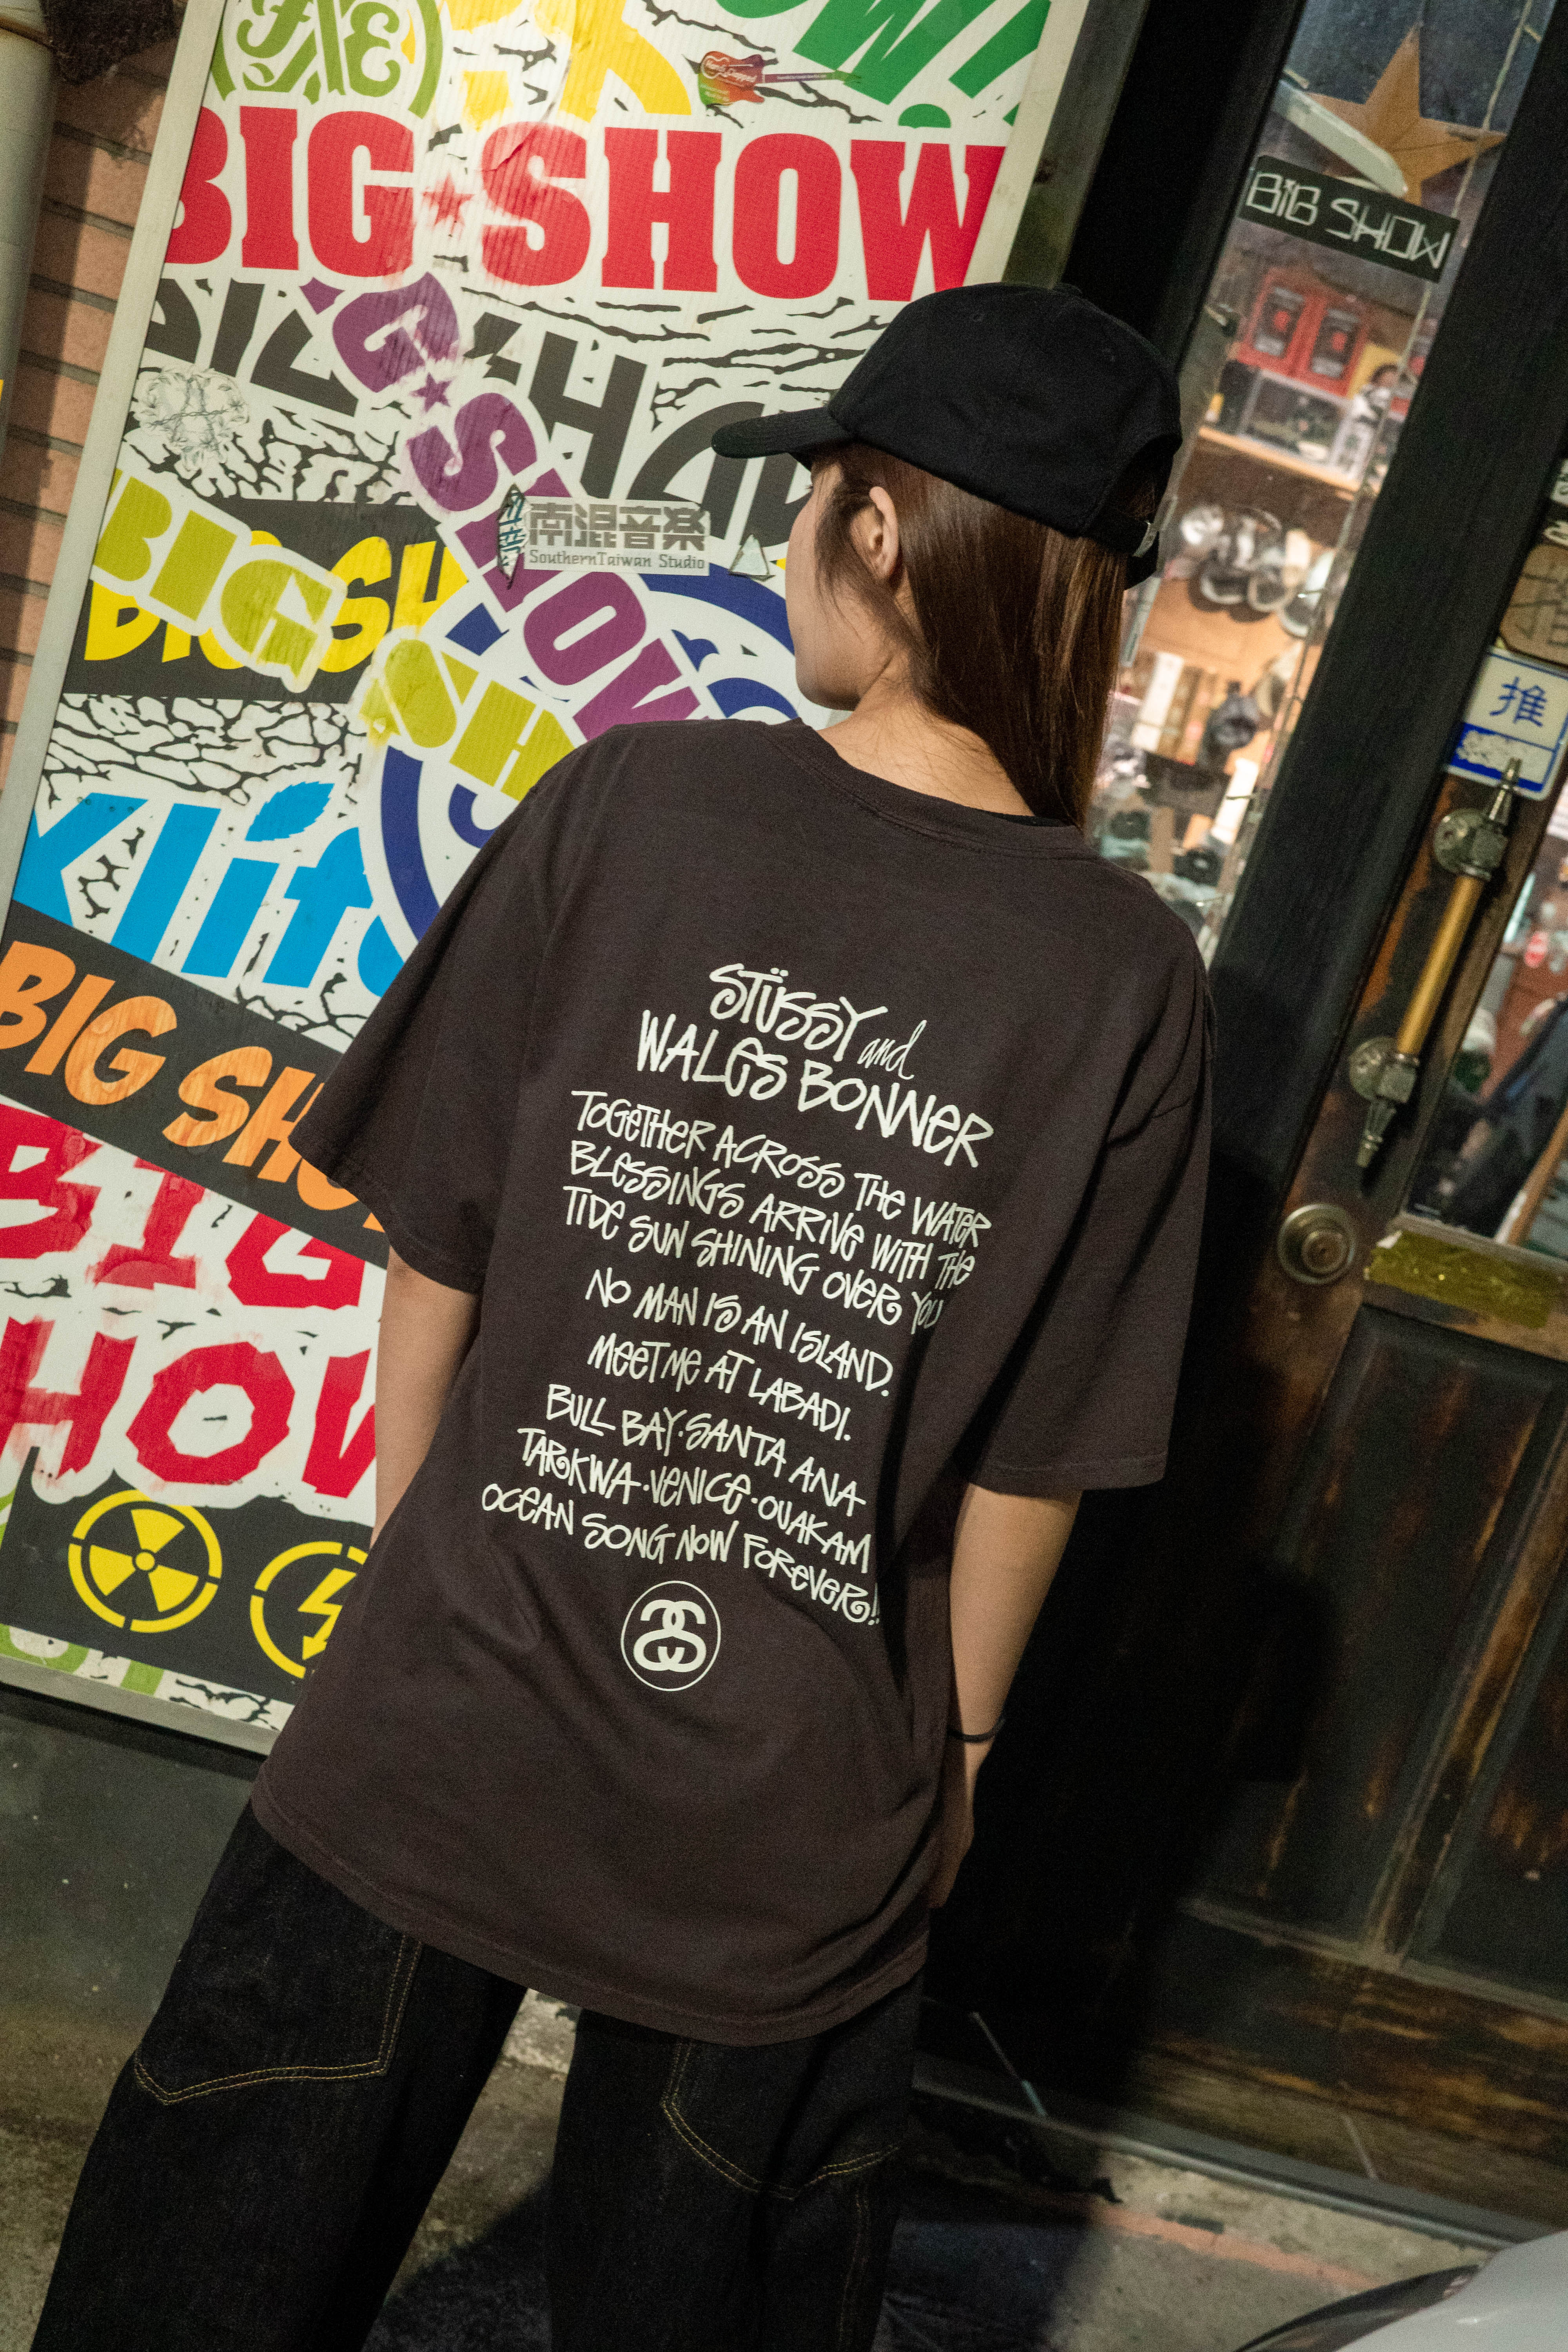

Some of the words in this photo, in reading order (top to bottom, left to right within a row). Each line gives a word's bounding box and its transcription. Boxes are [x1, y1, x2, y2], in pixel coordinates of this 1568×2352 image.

[482, 121, 1007, 303] SHOW
[1324, 196, 1451, 270] SHOW
[659, 554, 706, 570] Studio
[1490, 676, 1547, 728] 推
[0, 940, 177, 1105] BIG
[709, 963, 888, 1062] STÜSSY
[858, 1020, 927, 1079] and
[637, 1009, 789, 1100] WALES
[797, 1059, 994, 1168] BONNER
[571, 1090, 716, 1159] TOGETHER
[712, 1125, 845, 1198] ACROSS
[853, 1172, 906, 1220] THE
[911, 1196, 992, 1249] WATER
[571, 1140, 746, 1219] BLESSINGS
[749, 1193, 865, 1261] ARRIVE
[870, 1233, 935, 1283] WITH
[934, 1249, 976, 1290] THE
[563, 1185, 626, 1240] TIDE
[628, 1215, 690, 1259] SUN
[691, 1227, 820, 1296] SHINING
[822, 1269, 902, 1326] OVER
[911, 1291, 944, 1335] YOU
[585, 1266, 632, 1308] NO
[633, 1282, 699, 1326] MAN
[702, 1292, 742, 1333] IS
[740, 1305, 789, 1350] AN
[789, 1322, 894, 1397] ISLAND.
[586, 1332, 671, 1384] MEET
[660, 1347, 702, 1392] ME
[704, 1349, 756, 1394] AT
[748, 1368, 852, 1442] LABADI.
[546, 1383, 616, 1437] BULL
[788, 1456, 867, 1517] ANA
[481, 1483, 574, 1536] OCEAN
[581, 1513, 677, 1565] SONG
[674, 1520, 740, 1563] NOW
